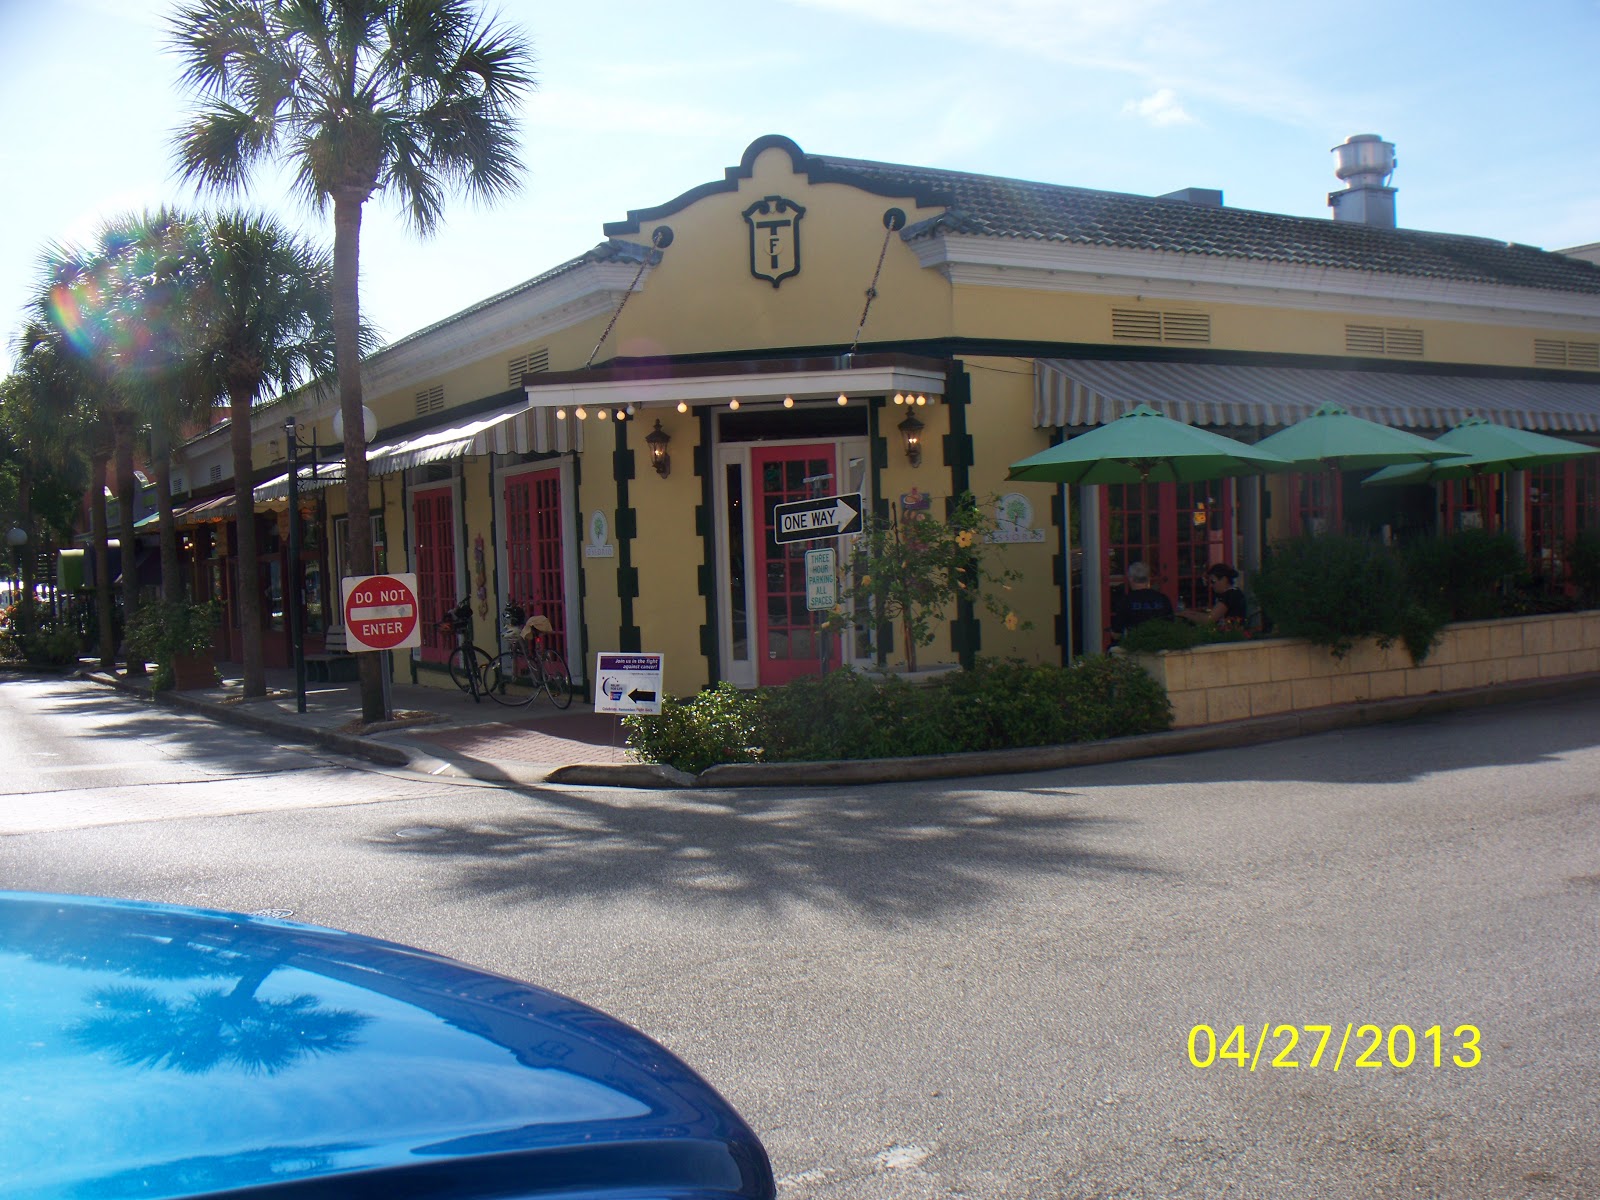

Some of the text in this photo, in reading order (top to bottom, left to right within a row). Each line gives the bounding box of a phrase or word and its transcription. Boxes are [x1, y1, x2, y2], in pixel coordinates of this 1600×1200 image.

[785, 509, 836, 530] ONE WAY
[811, 554, 830, 563] THREE
[812, 565, 829, 573] HOUR
[809, 575, 833, 584] PARKING
[816, 586, 827, 595] ALL
[355, 589, 406, 604] DO NOT
[811, 596, 832, 606] SPACES
[362, 621, 403, 636] ENTER
